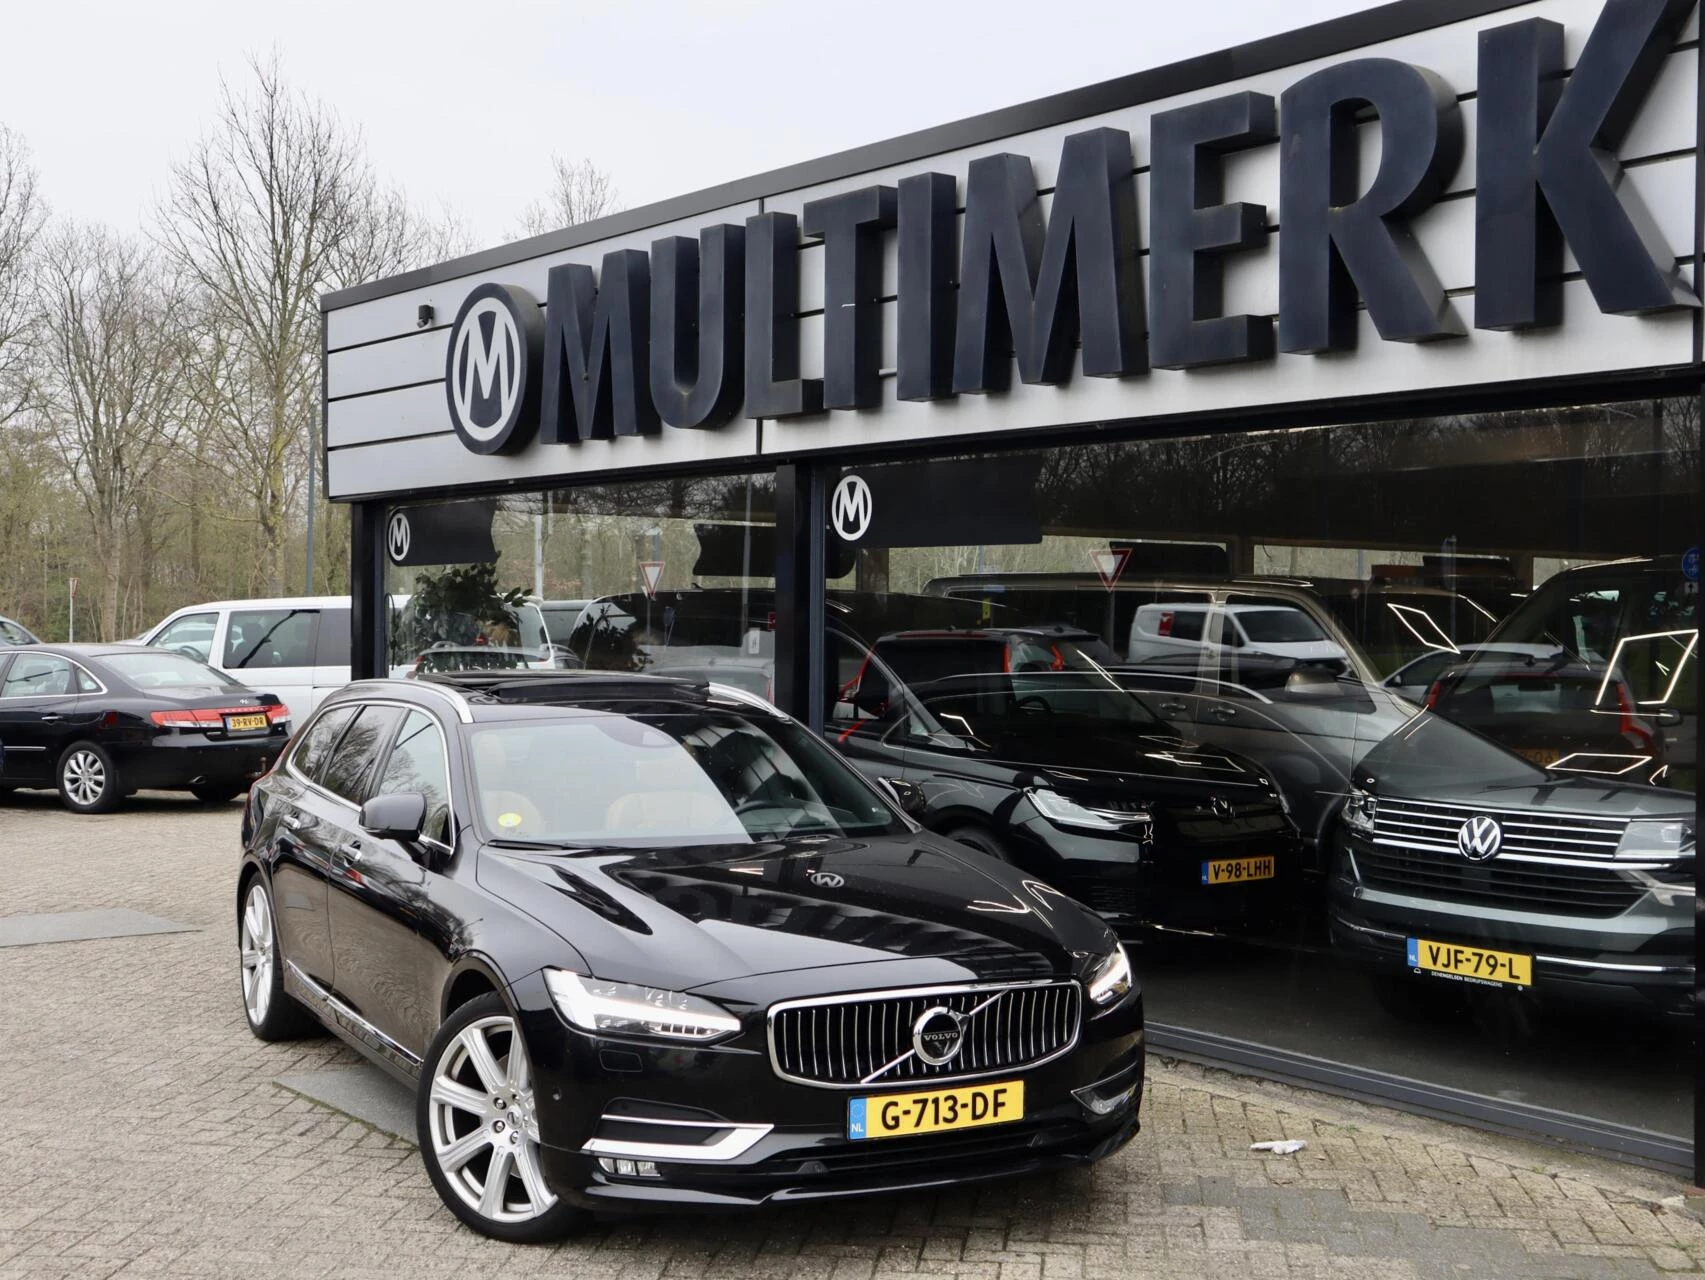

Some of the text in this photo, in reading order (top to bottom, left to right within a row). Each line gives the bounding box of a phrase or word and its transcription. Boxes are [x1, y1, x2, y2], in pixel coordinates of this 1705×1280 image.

[452, 0, 1703, 446] M MULTIMERK
[832, 475, 873, 541] M
[231, 716, 264, 728] 39-RV-DR
[1213, 860, 1271, 880] V-98-LHH
[1428, 945, 1520, 980] VJF-79-L
[923, 1032, 958, 1041] VOLVO
[851, 1088, 1007, 1133] NL G-713-DF
